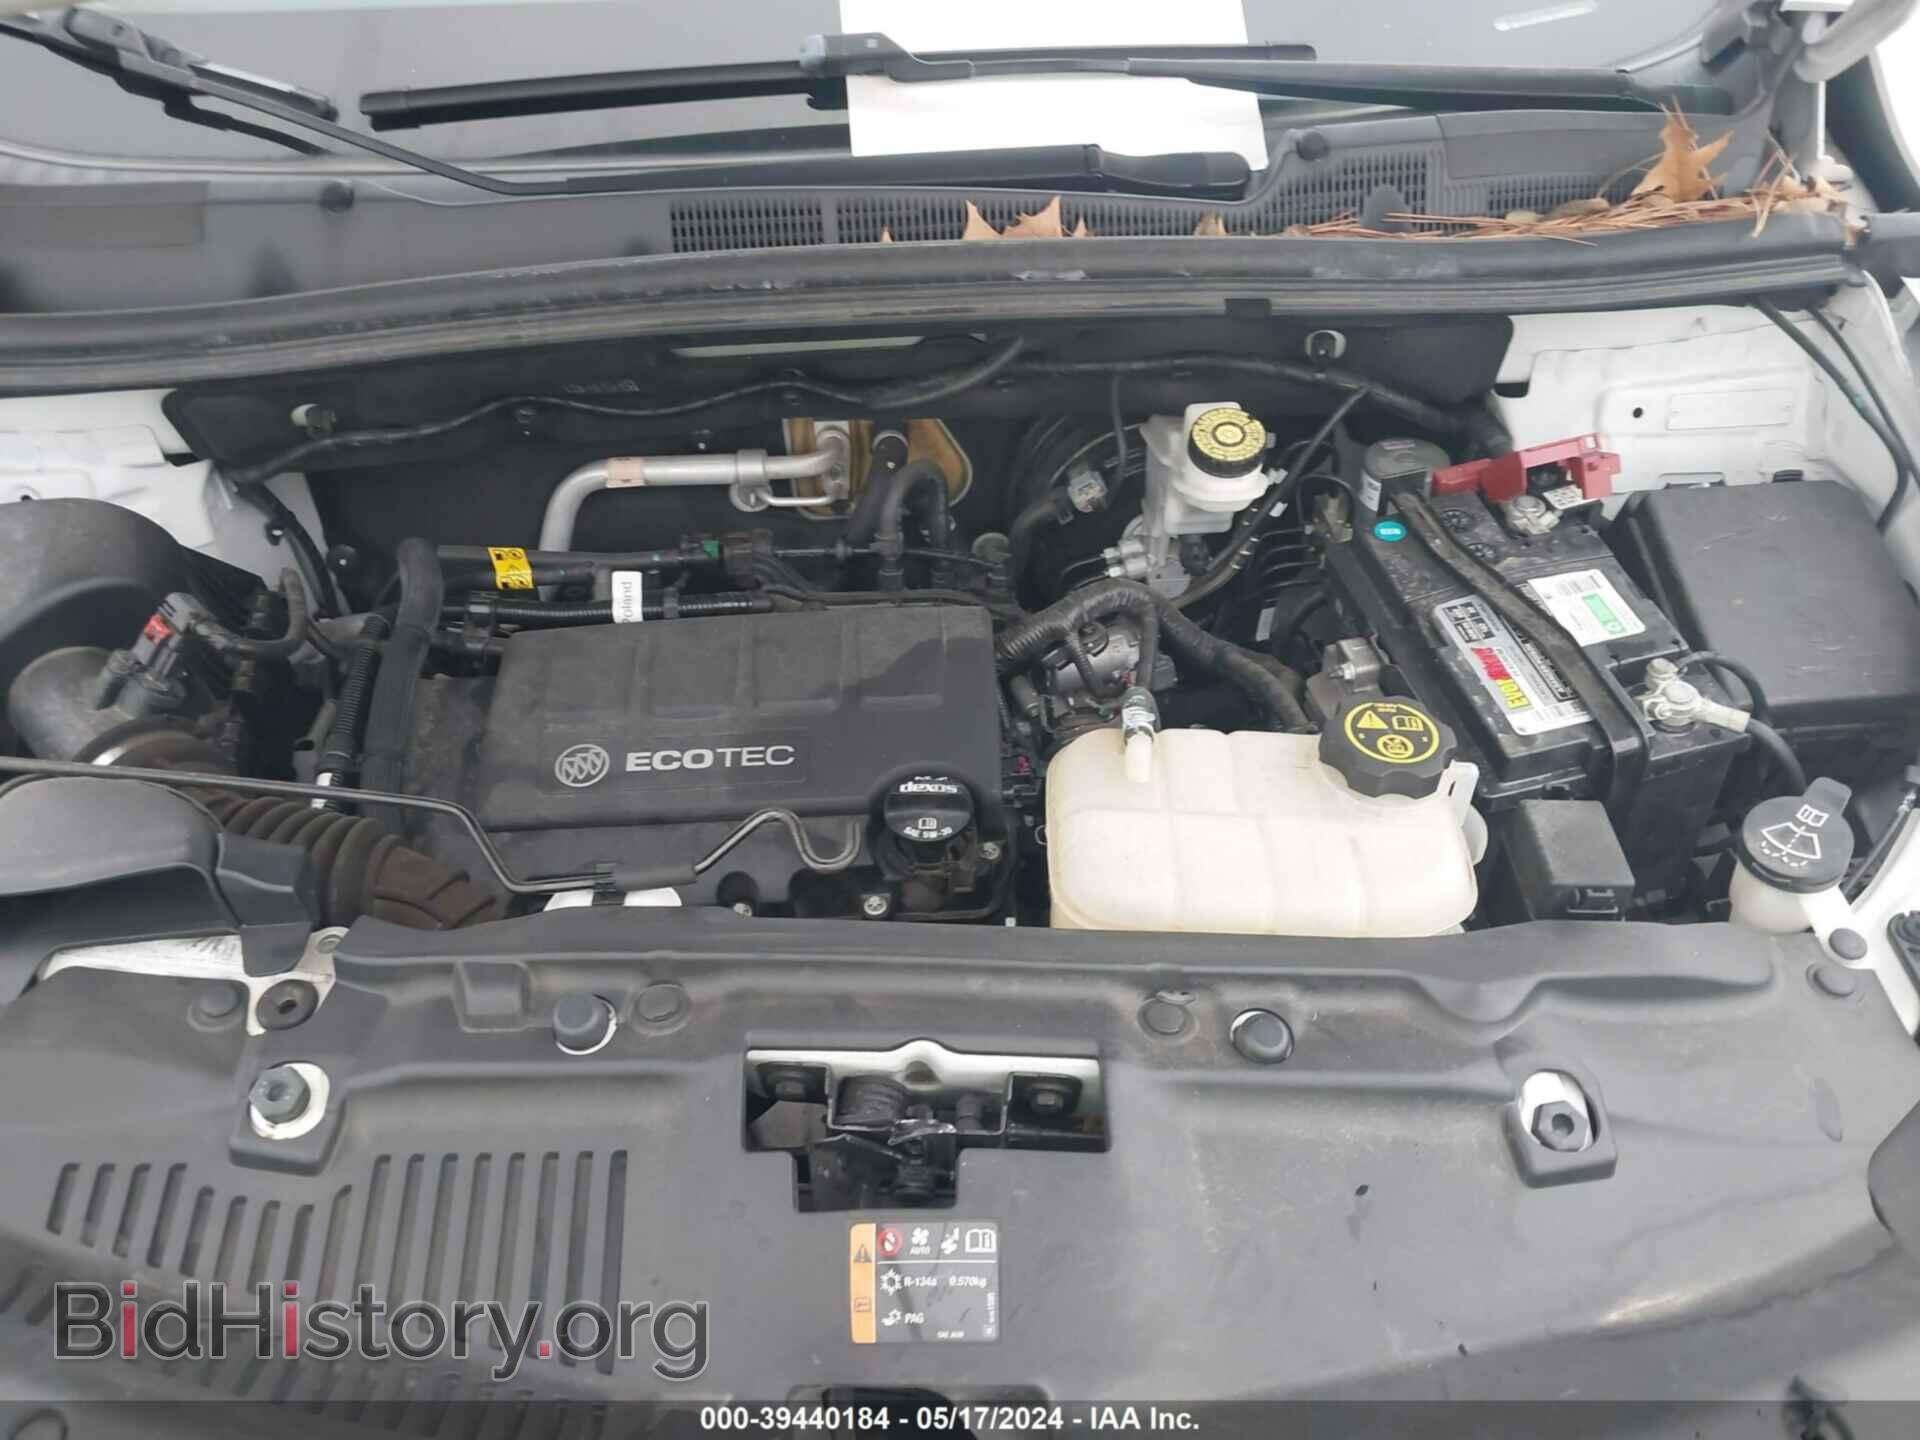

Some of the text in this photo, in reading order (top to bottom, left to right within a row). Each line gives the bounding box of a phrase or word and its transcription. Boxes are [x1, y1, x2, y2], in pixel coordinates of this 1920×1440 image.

[625, 745, 795, 772] ECOTEC
[899, 781, 958, 793] dexos
[904, 1312, 925, 1325] PAG
